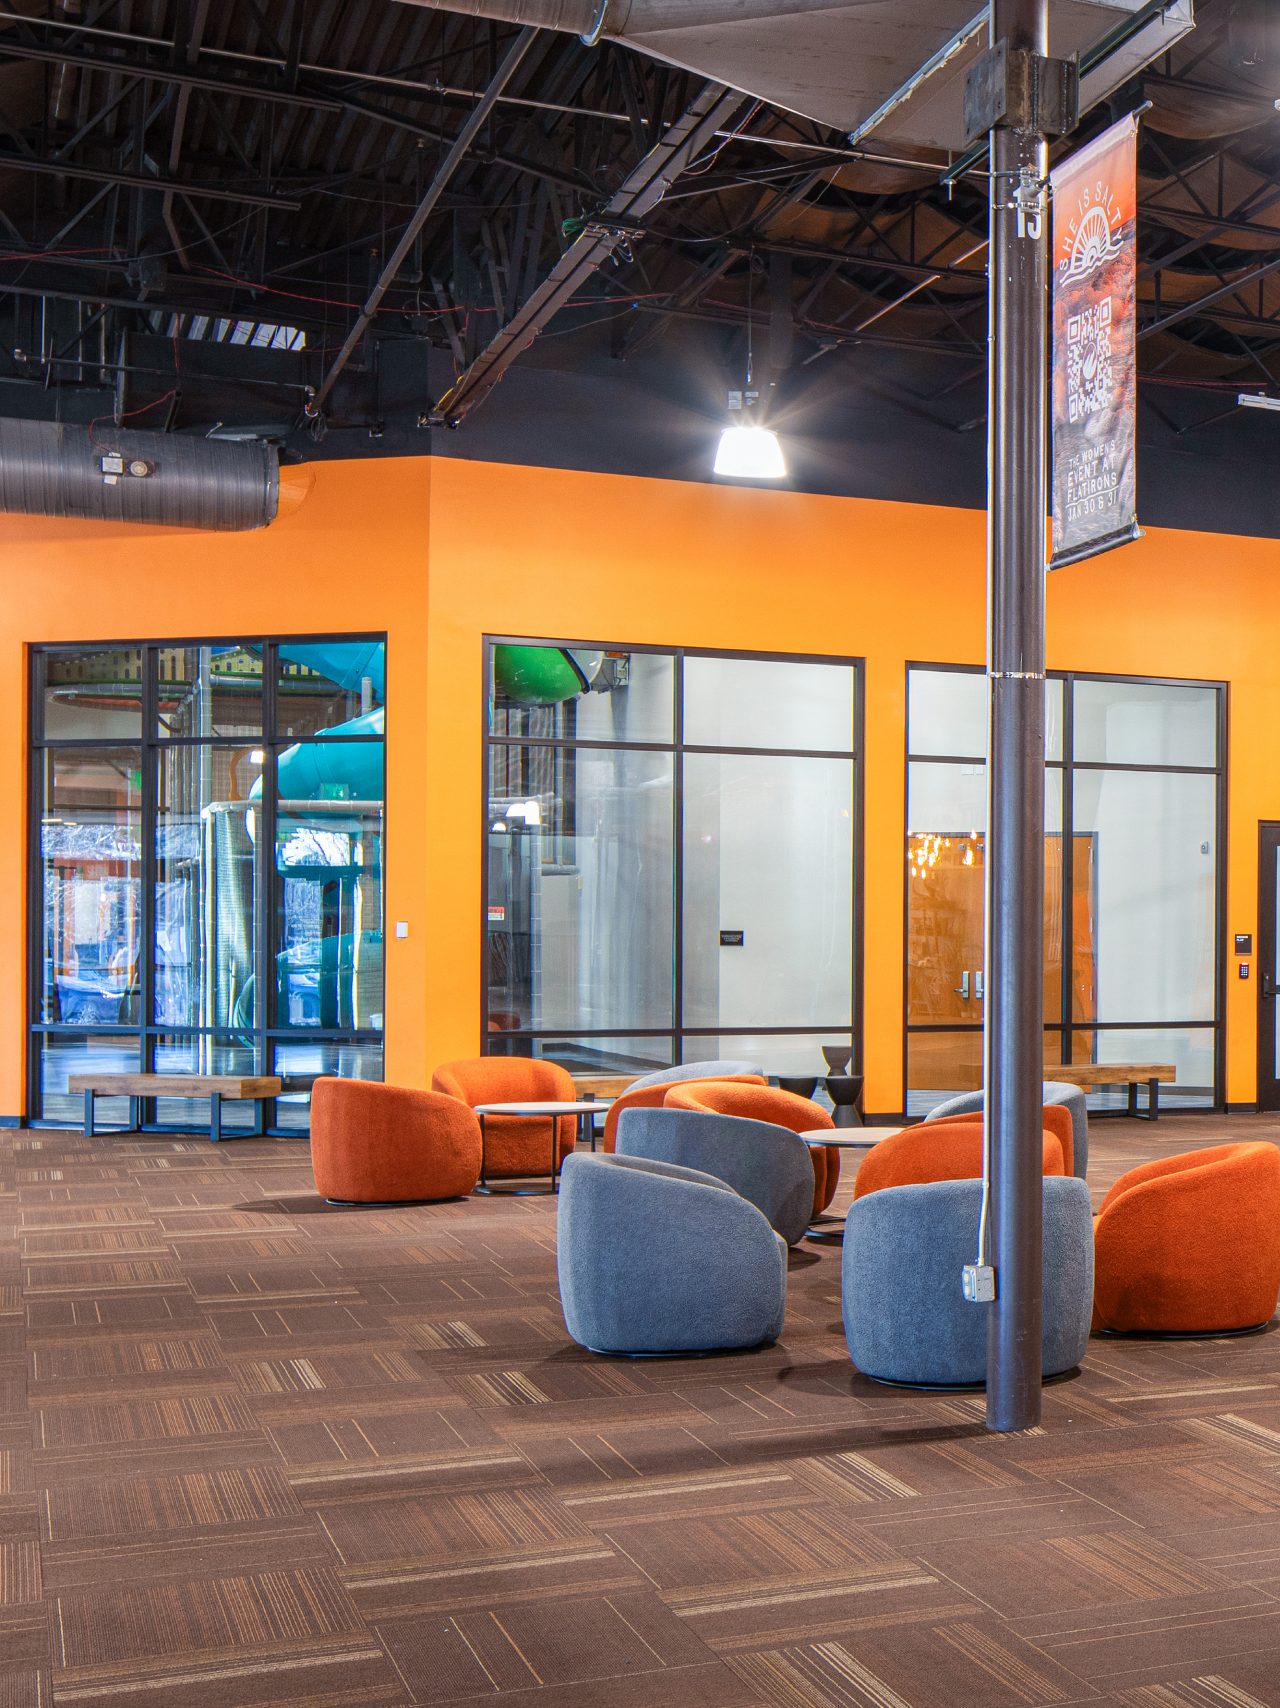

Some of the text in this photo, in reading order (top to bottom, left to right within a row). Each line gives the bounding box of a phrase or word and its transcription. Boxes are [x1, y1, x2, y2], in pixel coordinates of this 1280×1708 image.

[1060, 181, 1122, 271] SHE IS SALTY
[1067, 453, 1116, 488] EVENT AT
[1067, 471, 1117, 503] FLATIRONS
[1067, 503, 1082, 522] JAN
[1084, 498, 1095, 515] 30
[1107, 490, 1117, 507] 31
